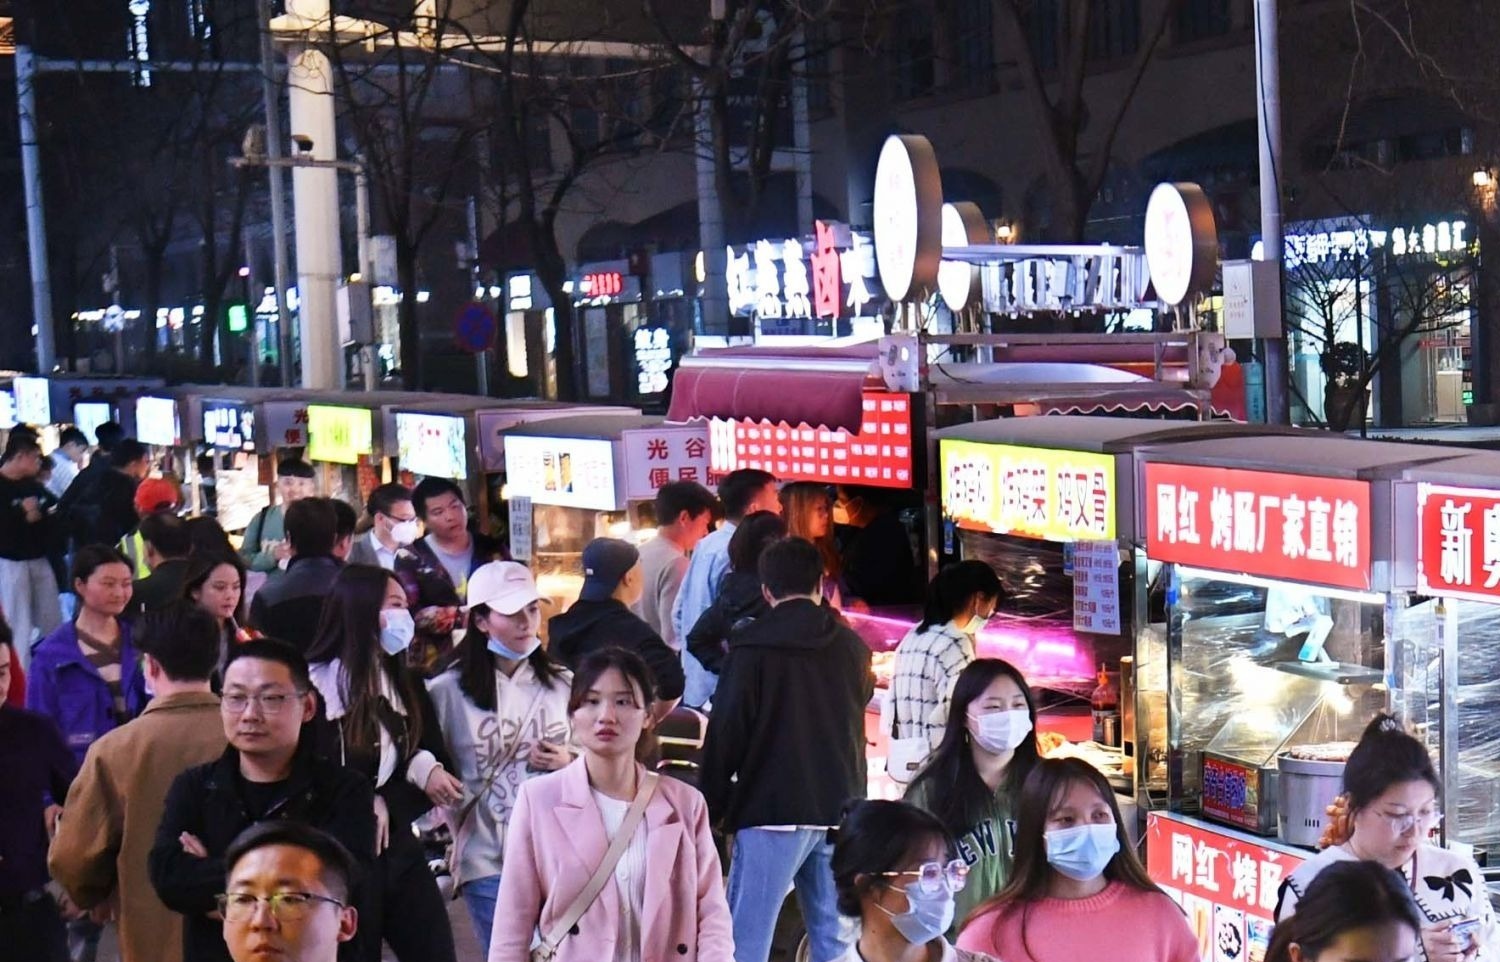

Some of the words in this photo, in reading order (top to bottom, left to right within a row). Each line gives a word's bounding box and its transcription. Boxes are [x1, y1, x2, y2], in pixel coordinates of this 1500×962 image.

[648, 437, 706, 461] 光谷
[1157, 484, 1200, 544] 网红
[1210, 487, 1359, 568] 烤肠厂家直销
[1171, 832, 1220, 892] 网红
